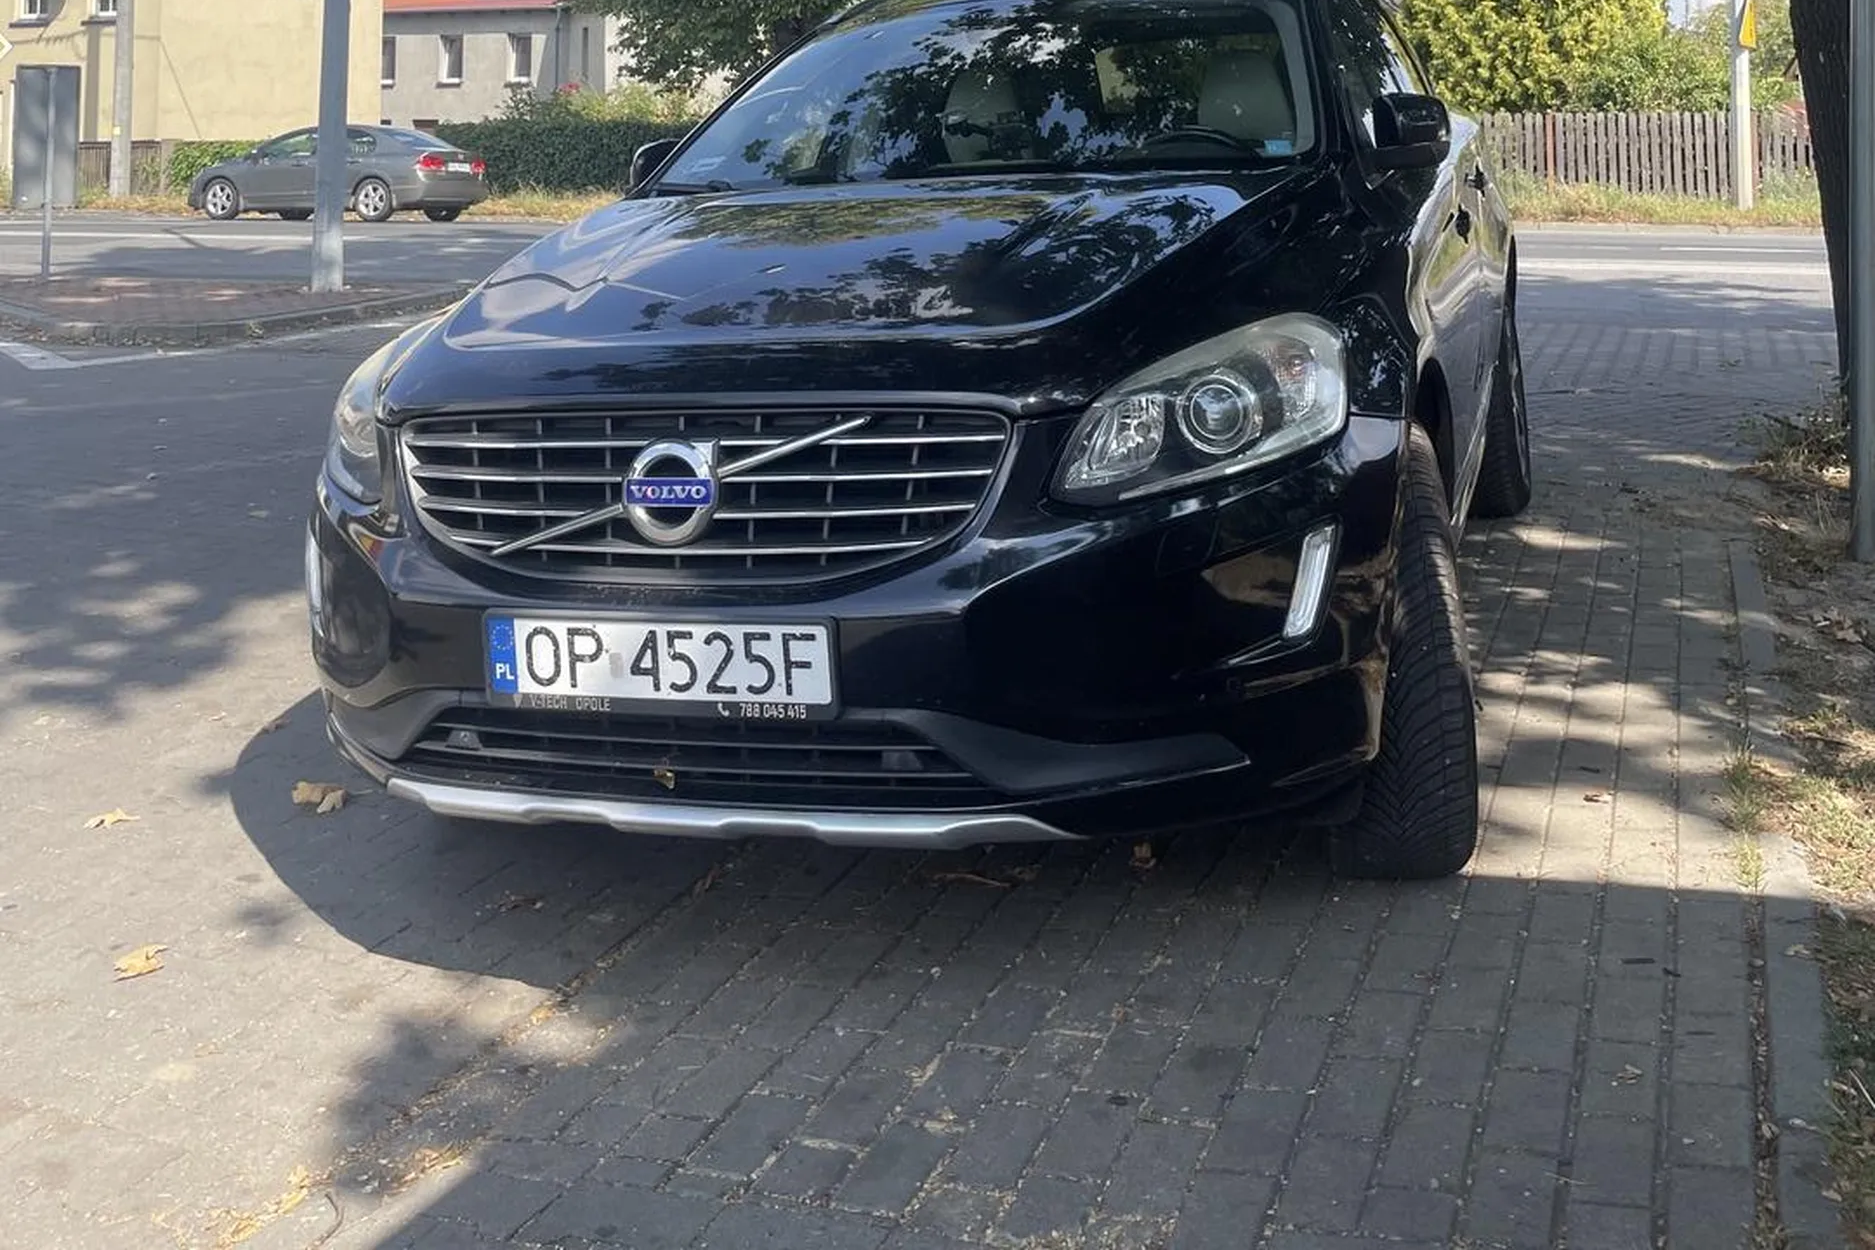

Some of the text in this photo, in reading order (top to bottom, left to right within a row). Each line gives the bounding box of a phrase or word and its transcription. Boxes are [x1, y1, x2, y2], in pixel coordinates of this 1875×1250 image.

[630, 485, 707, 499] VOLVO
[525, 625, 817, 696] OP 4525F
[495, 662, 515, 680] PL
[575, 697, 612, 711] OPOLE
[739, 702, 807, 720] 788 045 415
